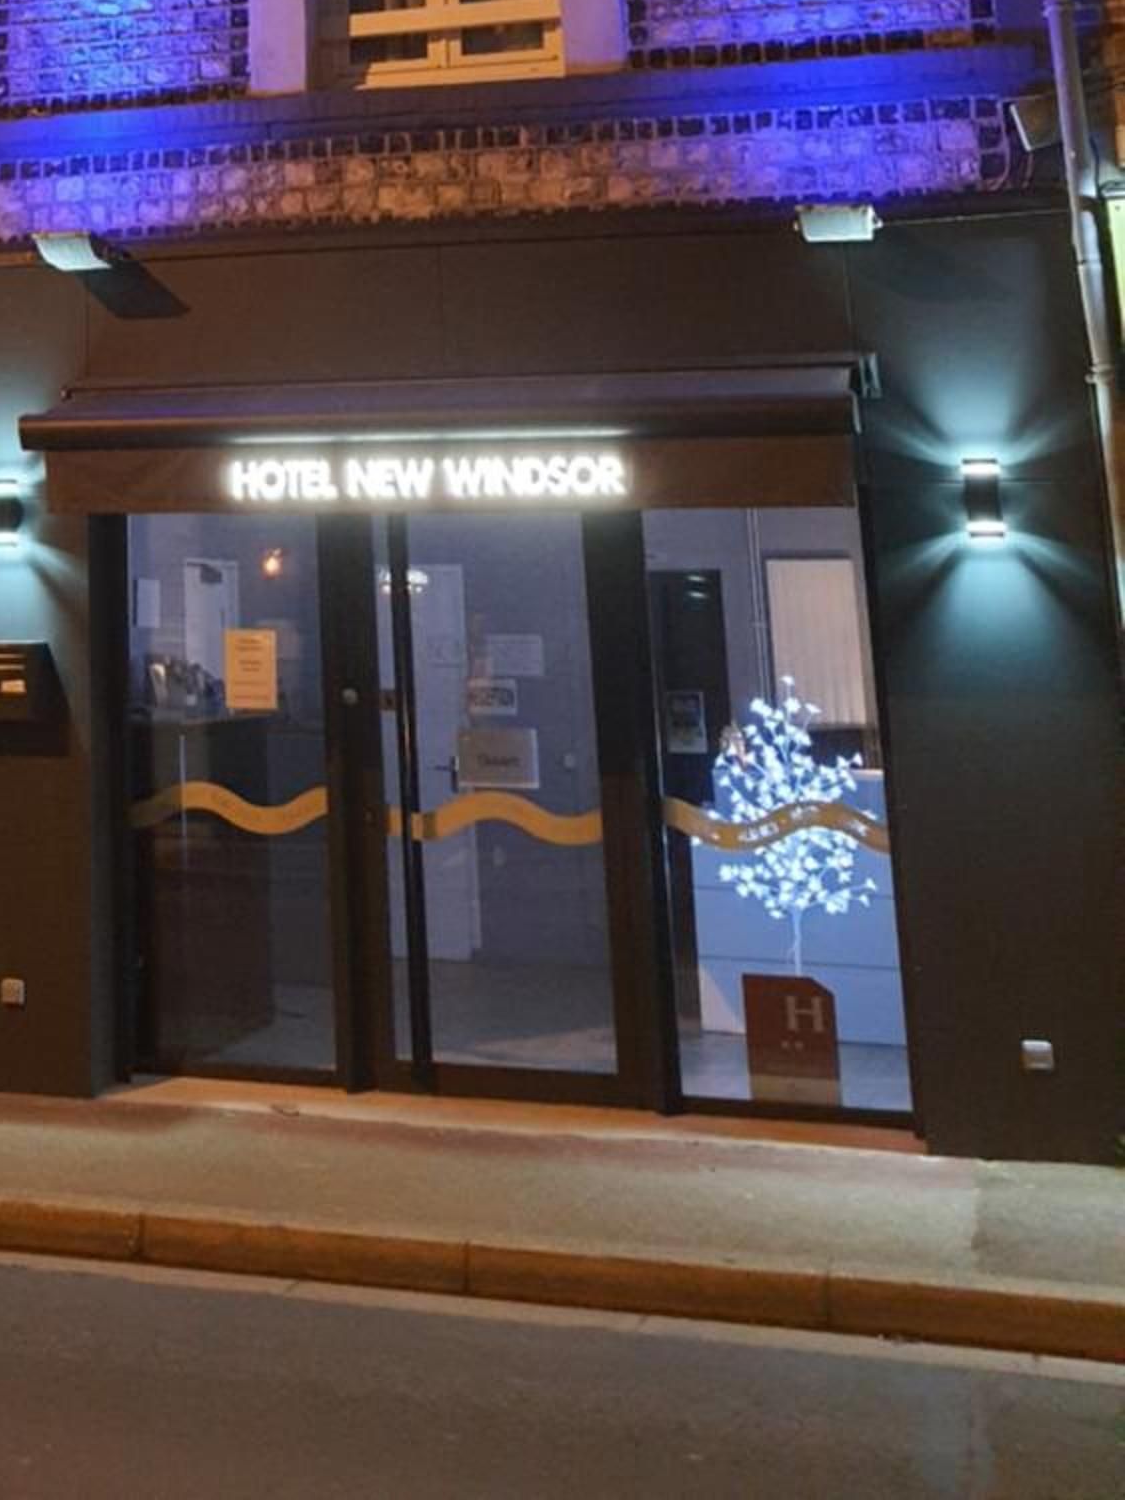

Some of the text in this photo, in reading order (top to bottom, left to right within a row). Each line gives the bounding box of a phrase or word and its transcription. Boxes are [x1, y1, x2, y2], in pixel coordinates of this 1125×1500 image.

[230, 455, 627, 501] HOTEL NEW WINDSOR
[785, 995, 823, 1032] H
